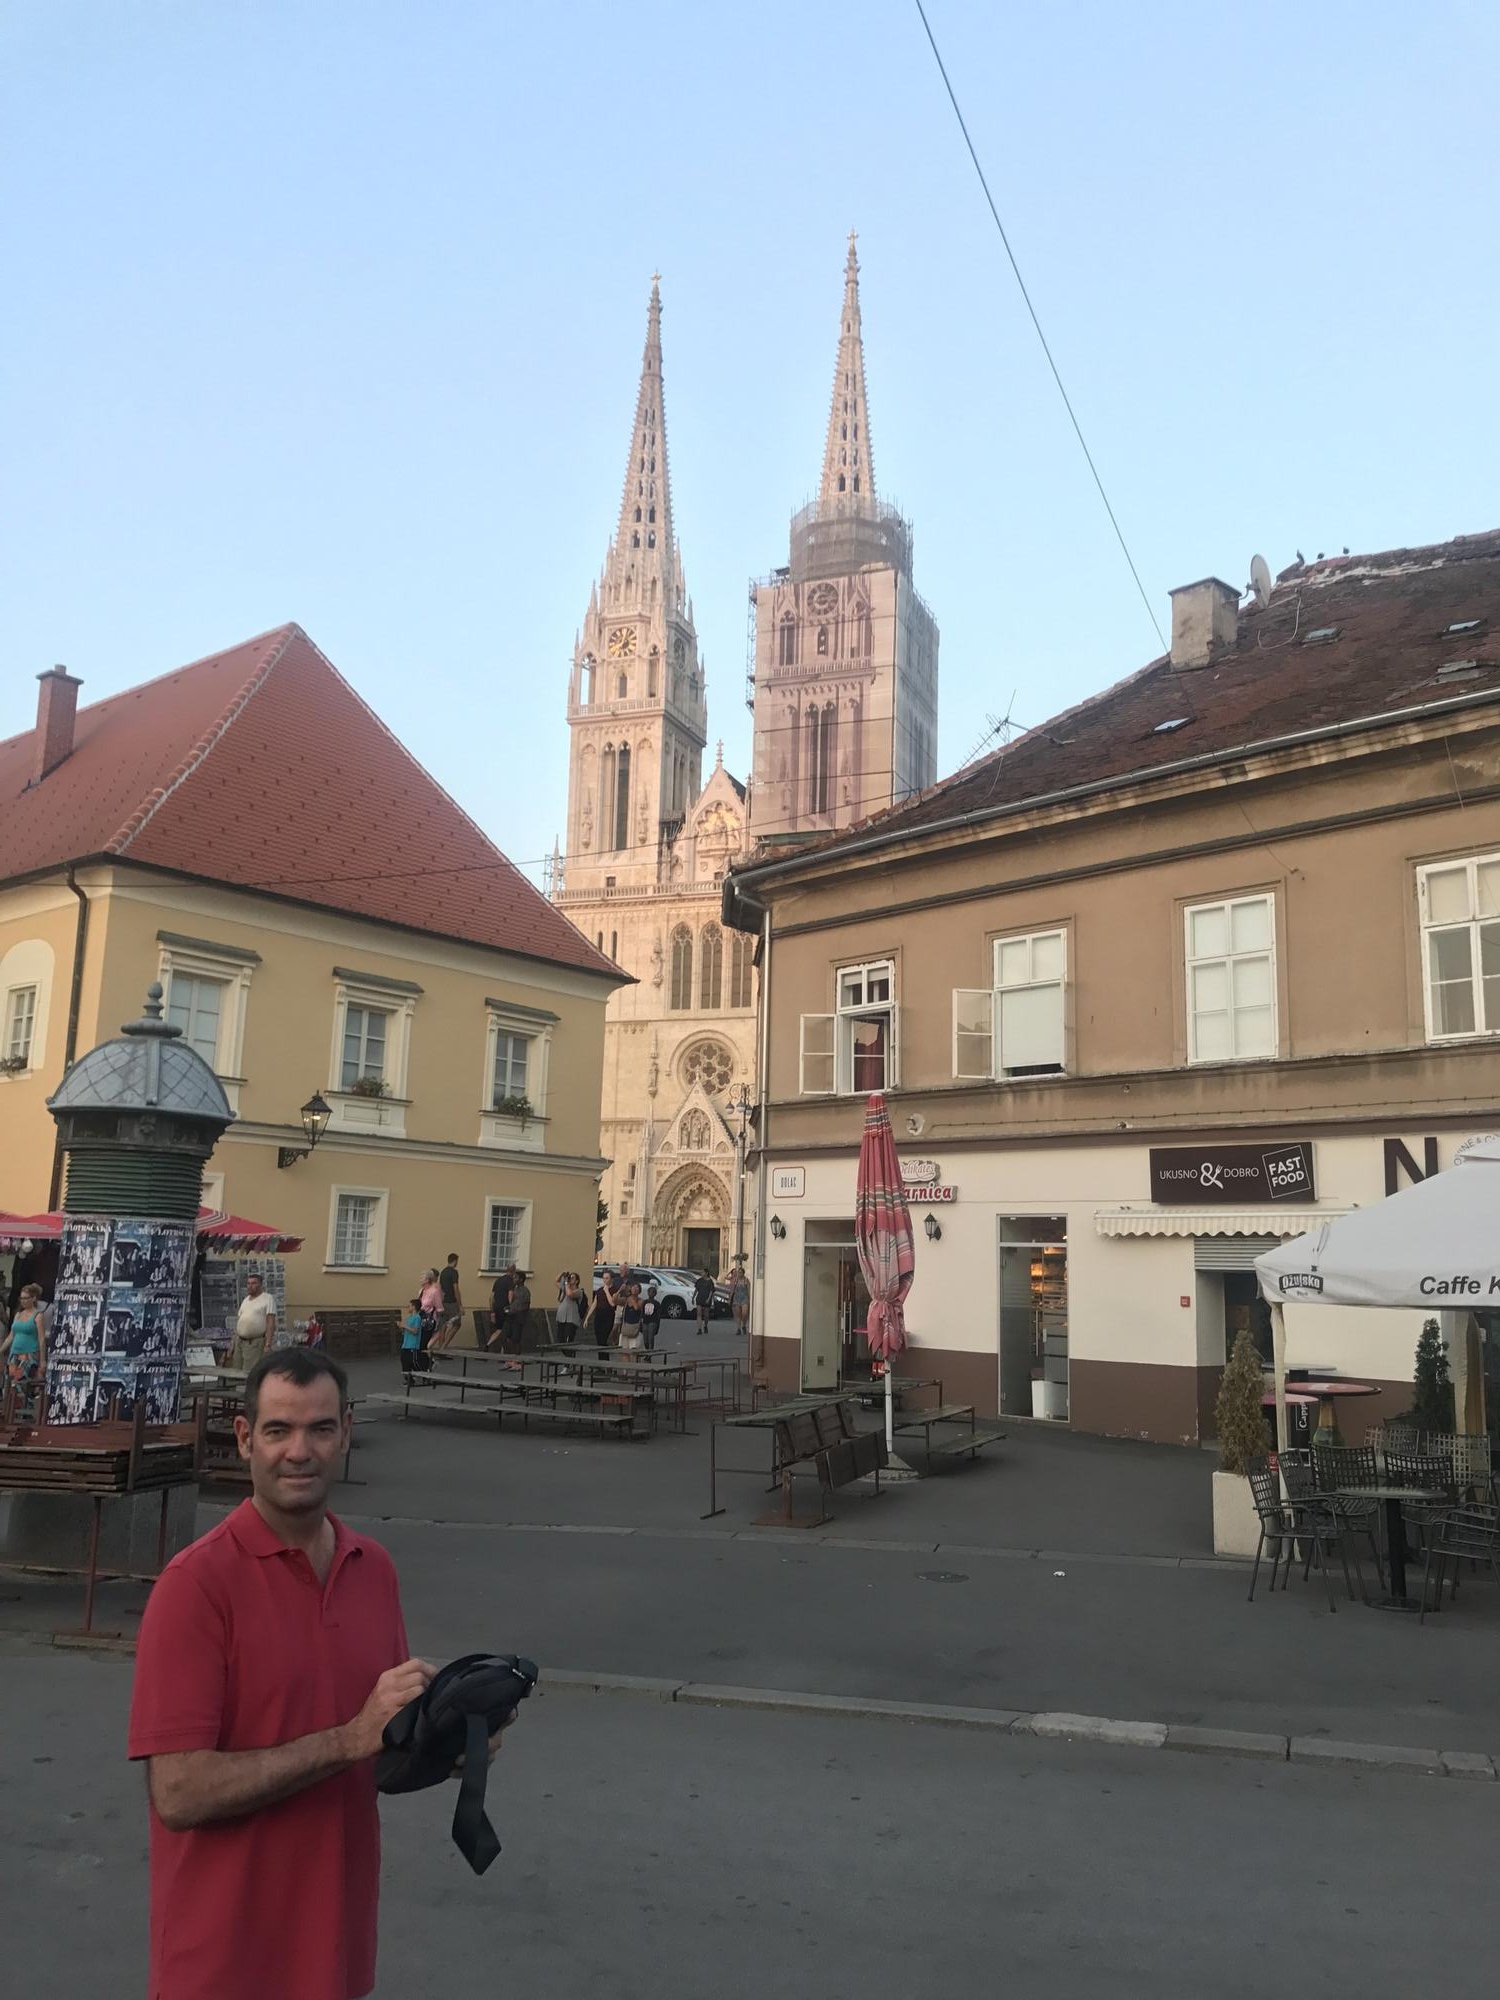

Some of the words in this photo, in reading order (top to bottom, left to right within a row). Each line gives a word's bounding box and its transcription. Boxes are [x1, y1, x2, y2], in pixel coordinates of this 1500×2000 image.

[1159, 1169, 1198, 1180] UKUSNO
[1223, 1167, 1260, 1178] DOBRO
[1268, 1156, 1301, 1176] FAST
[1271, 1170, 1305, 1188] FOOD
[903, 1182, 952, 1200] arnica
[1419, 1275, 1481, 1295] Caffe
